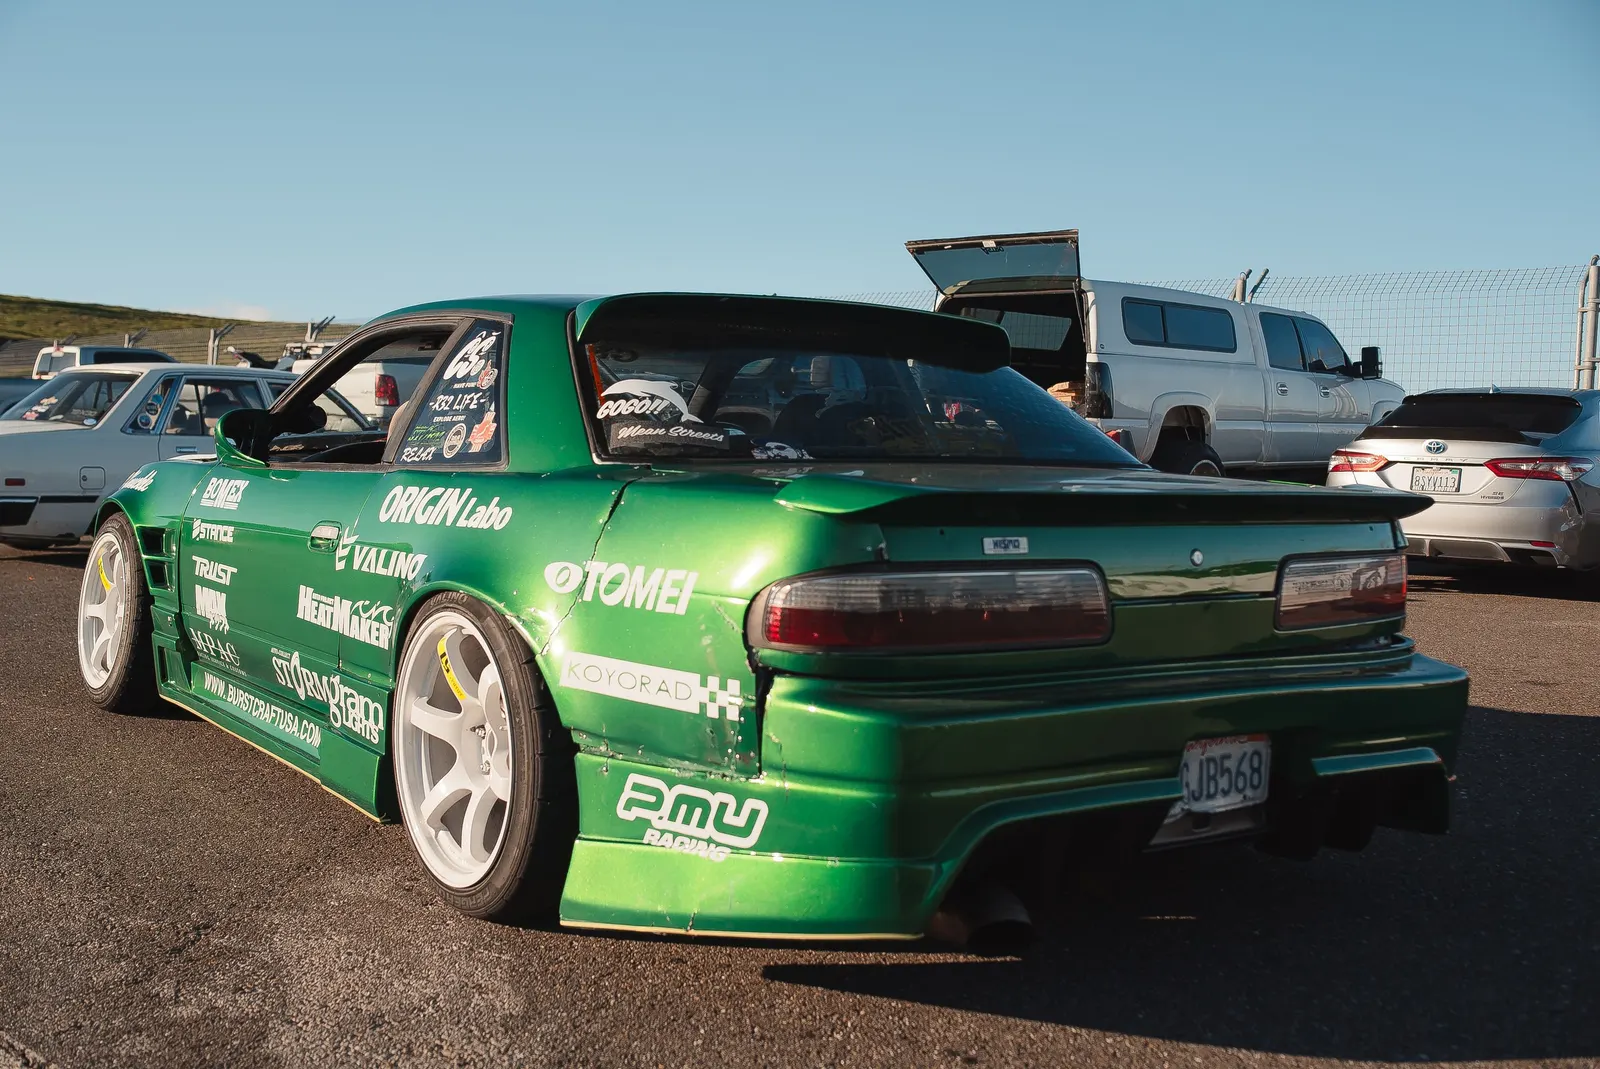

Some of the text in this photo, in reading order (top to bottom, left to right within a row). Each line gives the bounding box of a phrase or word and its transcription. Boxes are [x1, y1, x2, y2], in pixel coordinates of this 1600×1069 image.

[617, 424, 725, 442] Mean Streets
[202, 477, 250, 510] BOMEX
[1414, 475, 1457, 488] 8SYV113
[379, 485, 513, 531] ORIGIN Labo
[199, 522, 235, 543] STANCE
[192, 555, 238, 586] TRUST
[352, 544, 428, 581] VALINO
[582, 560, 699, 616] TOMEI
[567, 661, 692, 701] KOYORAD
[643, 828, 731, 862] RACING
